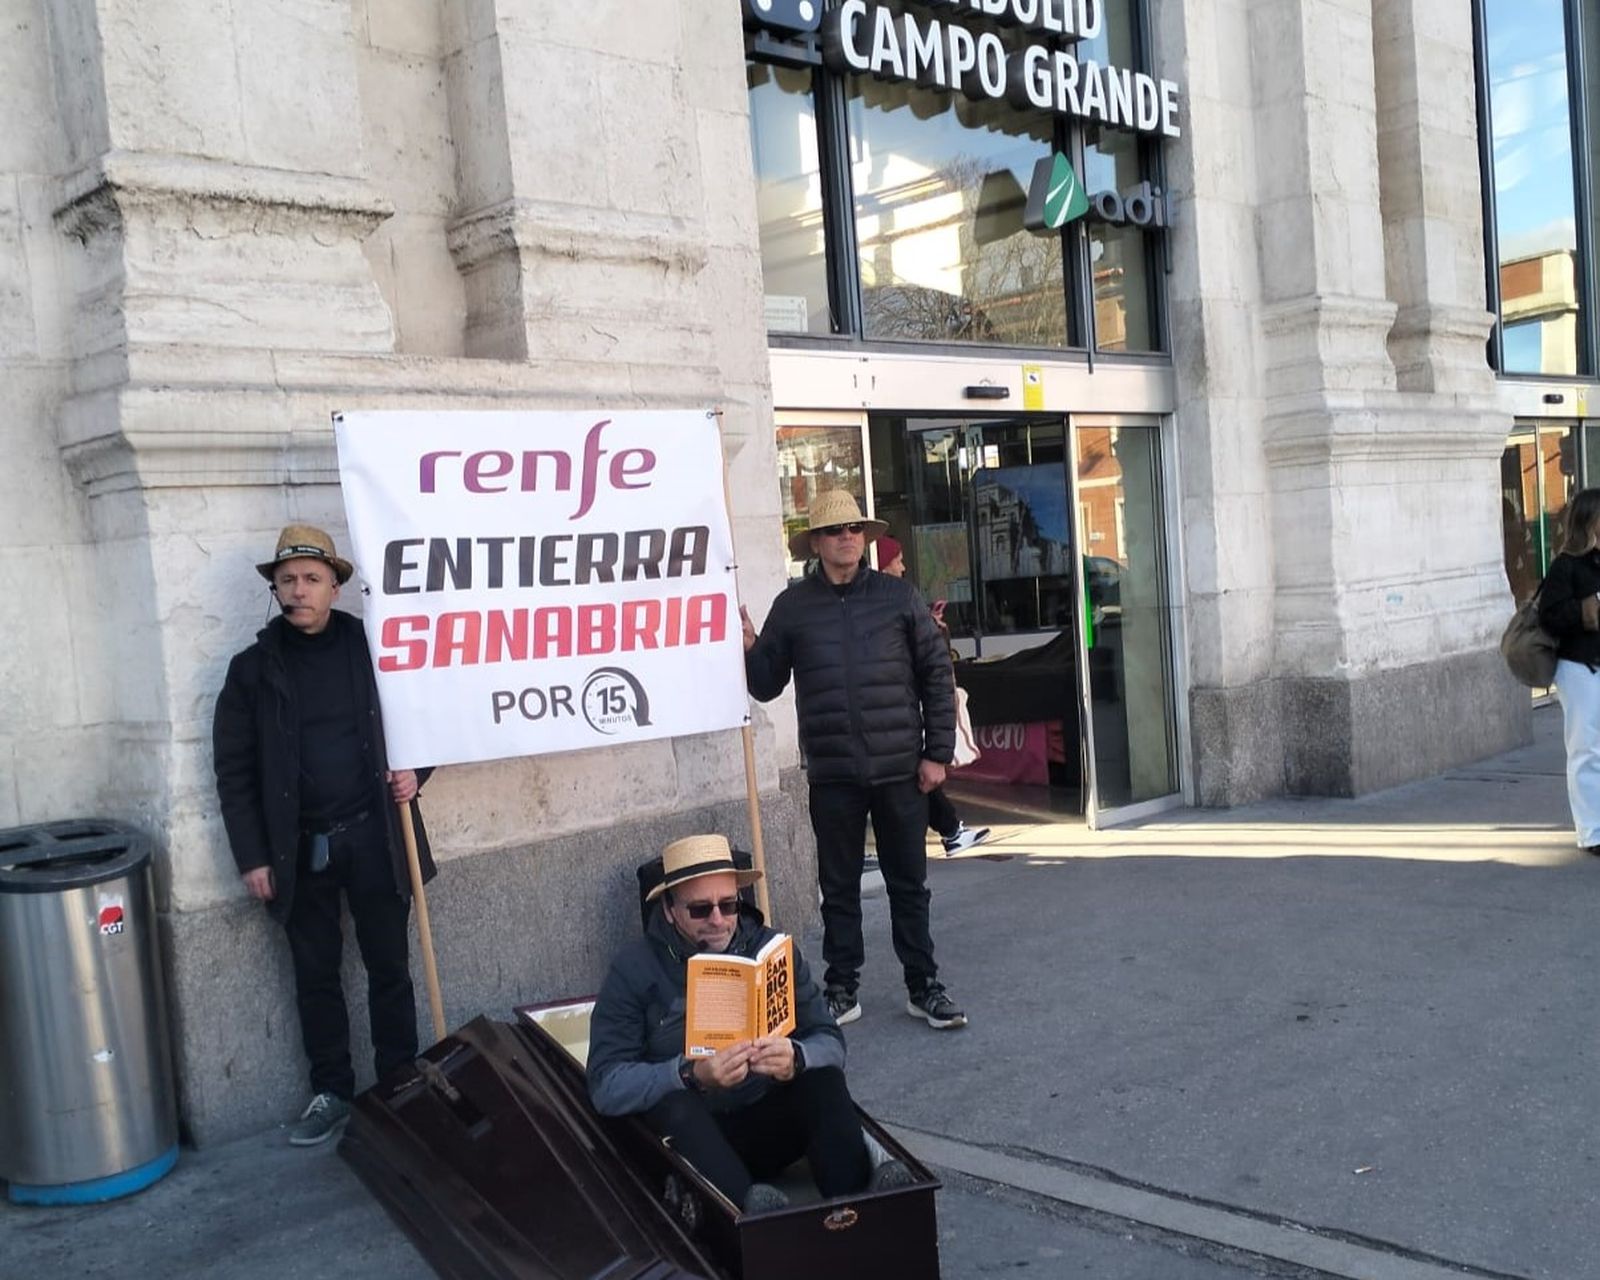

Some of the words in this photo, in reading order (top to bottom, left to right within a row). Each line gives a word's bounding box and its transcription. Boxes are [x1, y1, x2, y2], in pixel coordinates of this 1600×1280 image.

[840, 0, 1007, 98] CAMPO
[1024, 46, 1181, 137] GRANDE
[419, 420, 656, 520] renfe
[383, 525, 710, 595] ENTIERRA
[378, 593, 727, 672] SANABRIA
[492, 685, 575, 723] POR
[597, 685, 626, 715] 15
[100, 921, 123, 935] CGT
[767, 956, 787, 981] CAM
[767, 970, 788, 998] BIO
